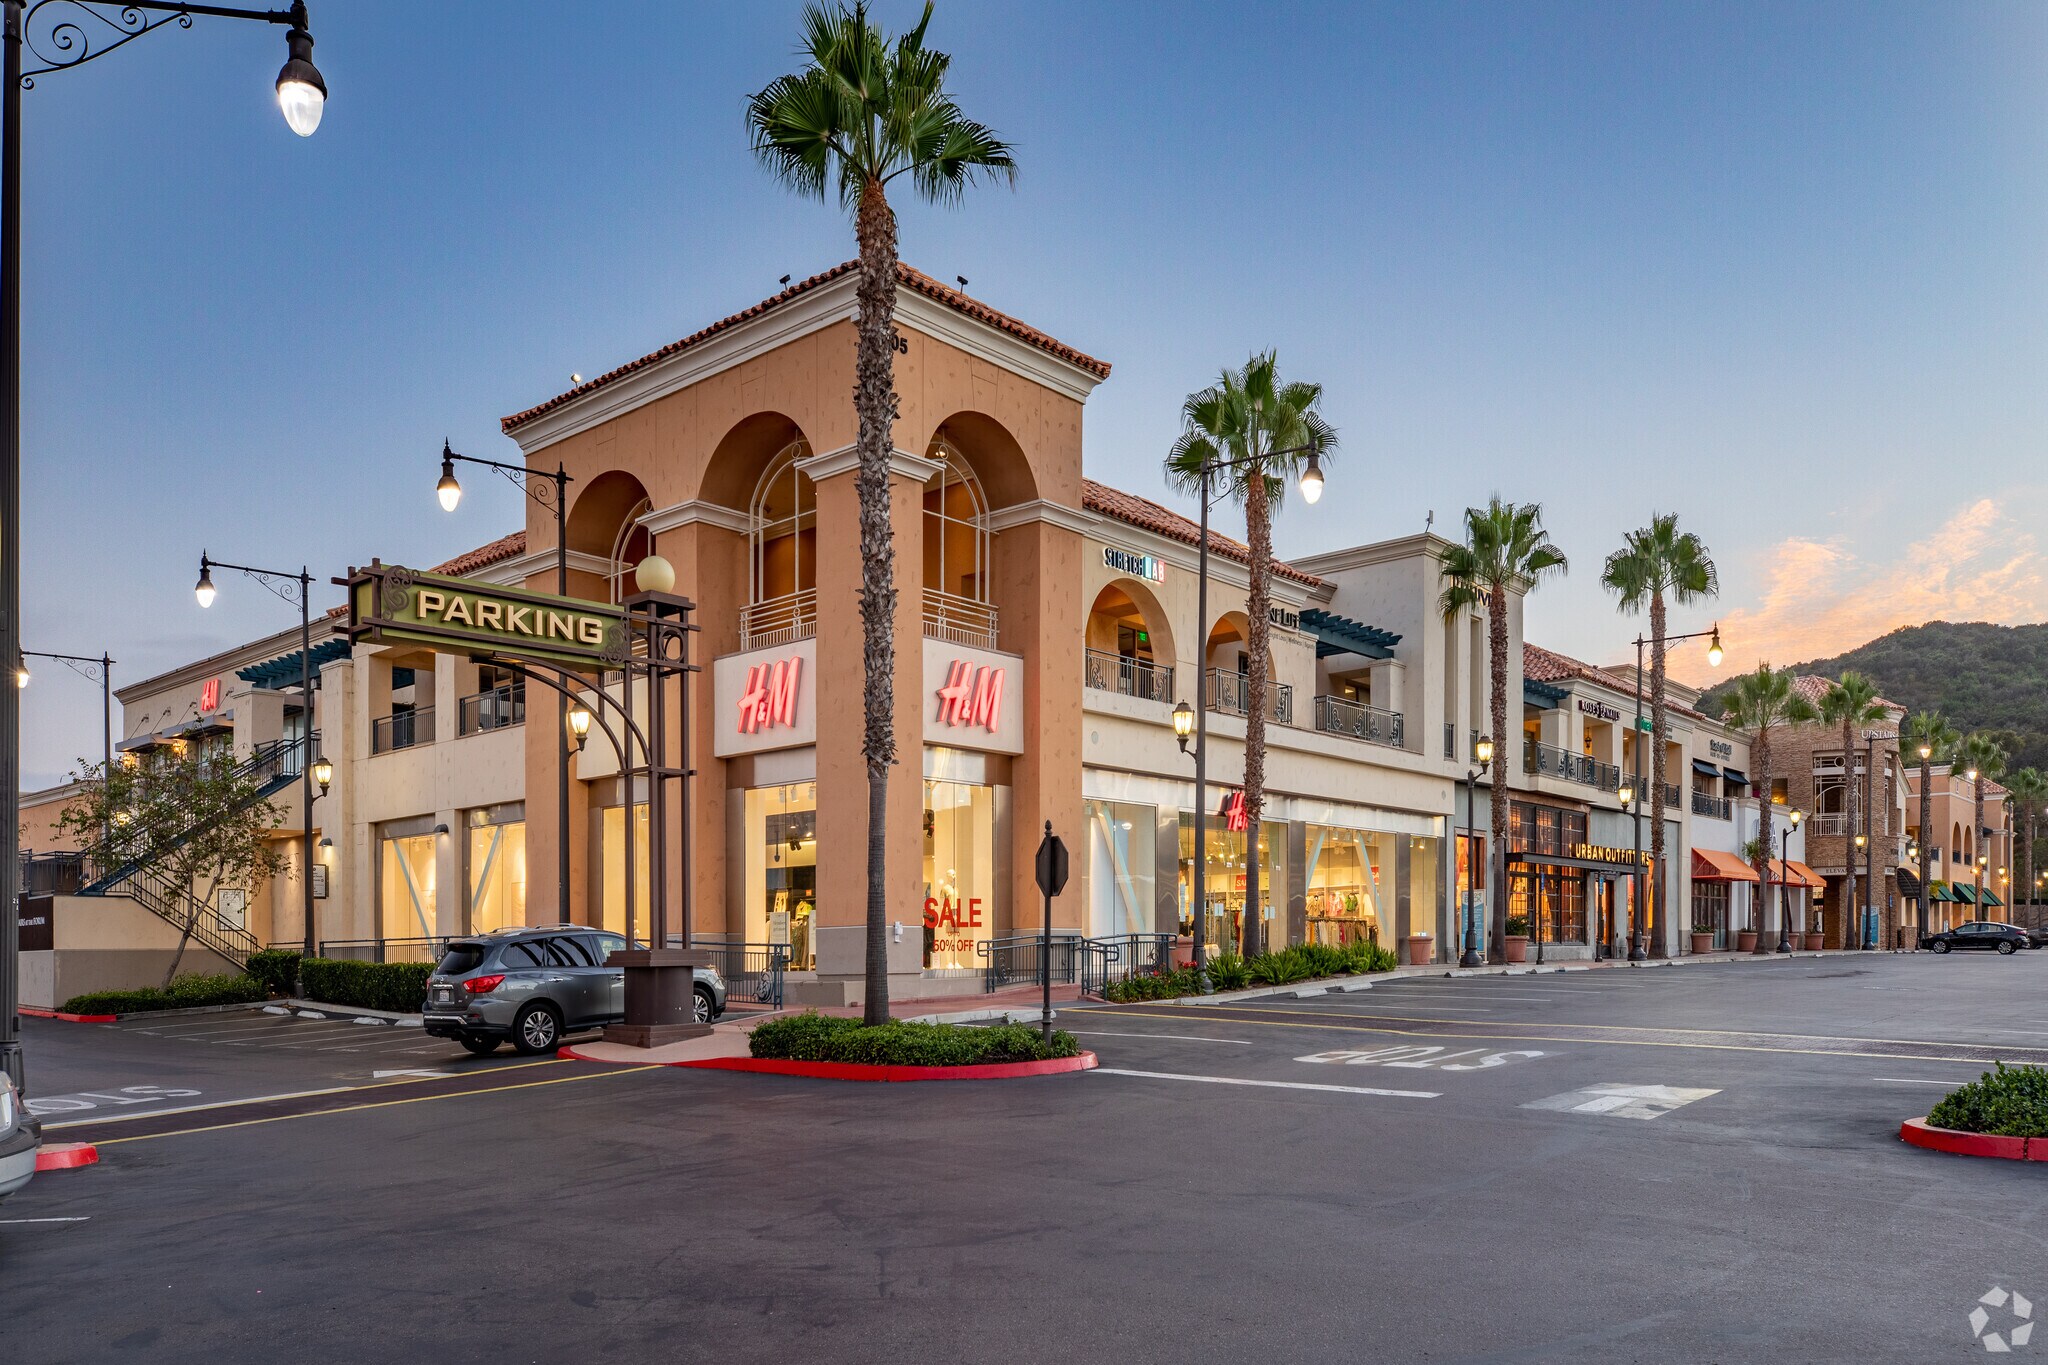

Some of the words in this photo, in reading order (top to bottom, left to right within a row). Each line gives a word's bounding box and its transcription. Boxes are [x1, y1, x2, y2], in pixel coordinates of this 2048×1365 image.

[891, 335, 907, 354] 05
[417, 590, 603, 644] PARKING
[201, 678, 220, 712] H&M
[737, 656, 803, 734] H&M
[935, 659, 1005, 734] H&M
[1575, 843, 1604, 861] URBAN
[1605, 847, 1652, 867] OUTFITTRS
[924, 897, 982, 928] SALE
[933, 939, 955, 952] 50%
[957, 939, 974, 952] OFF
[1293, 1045, 1546, 1071] STOP
